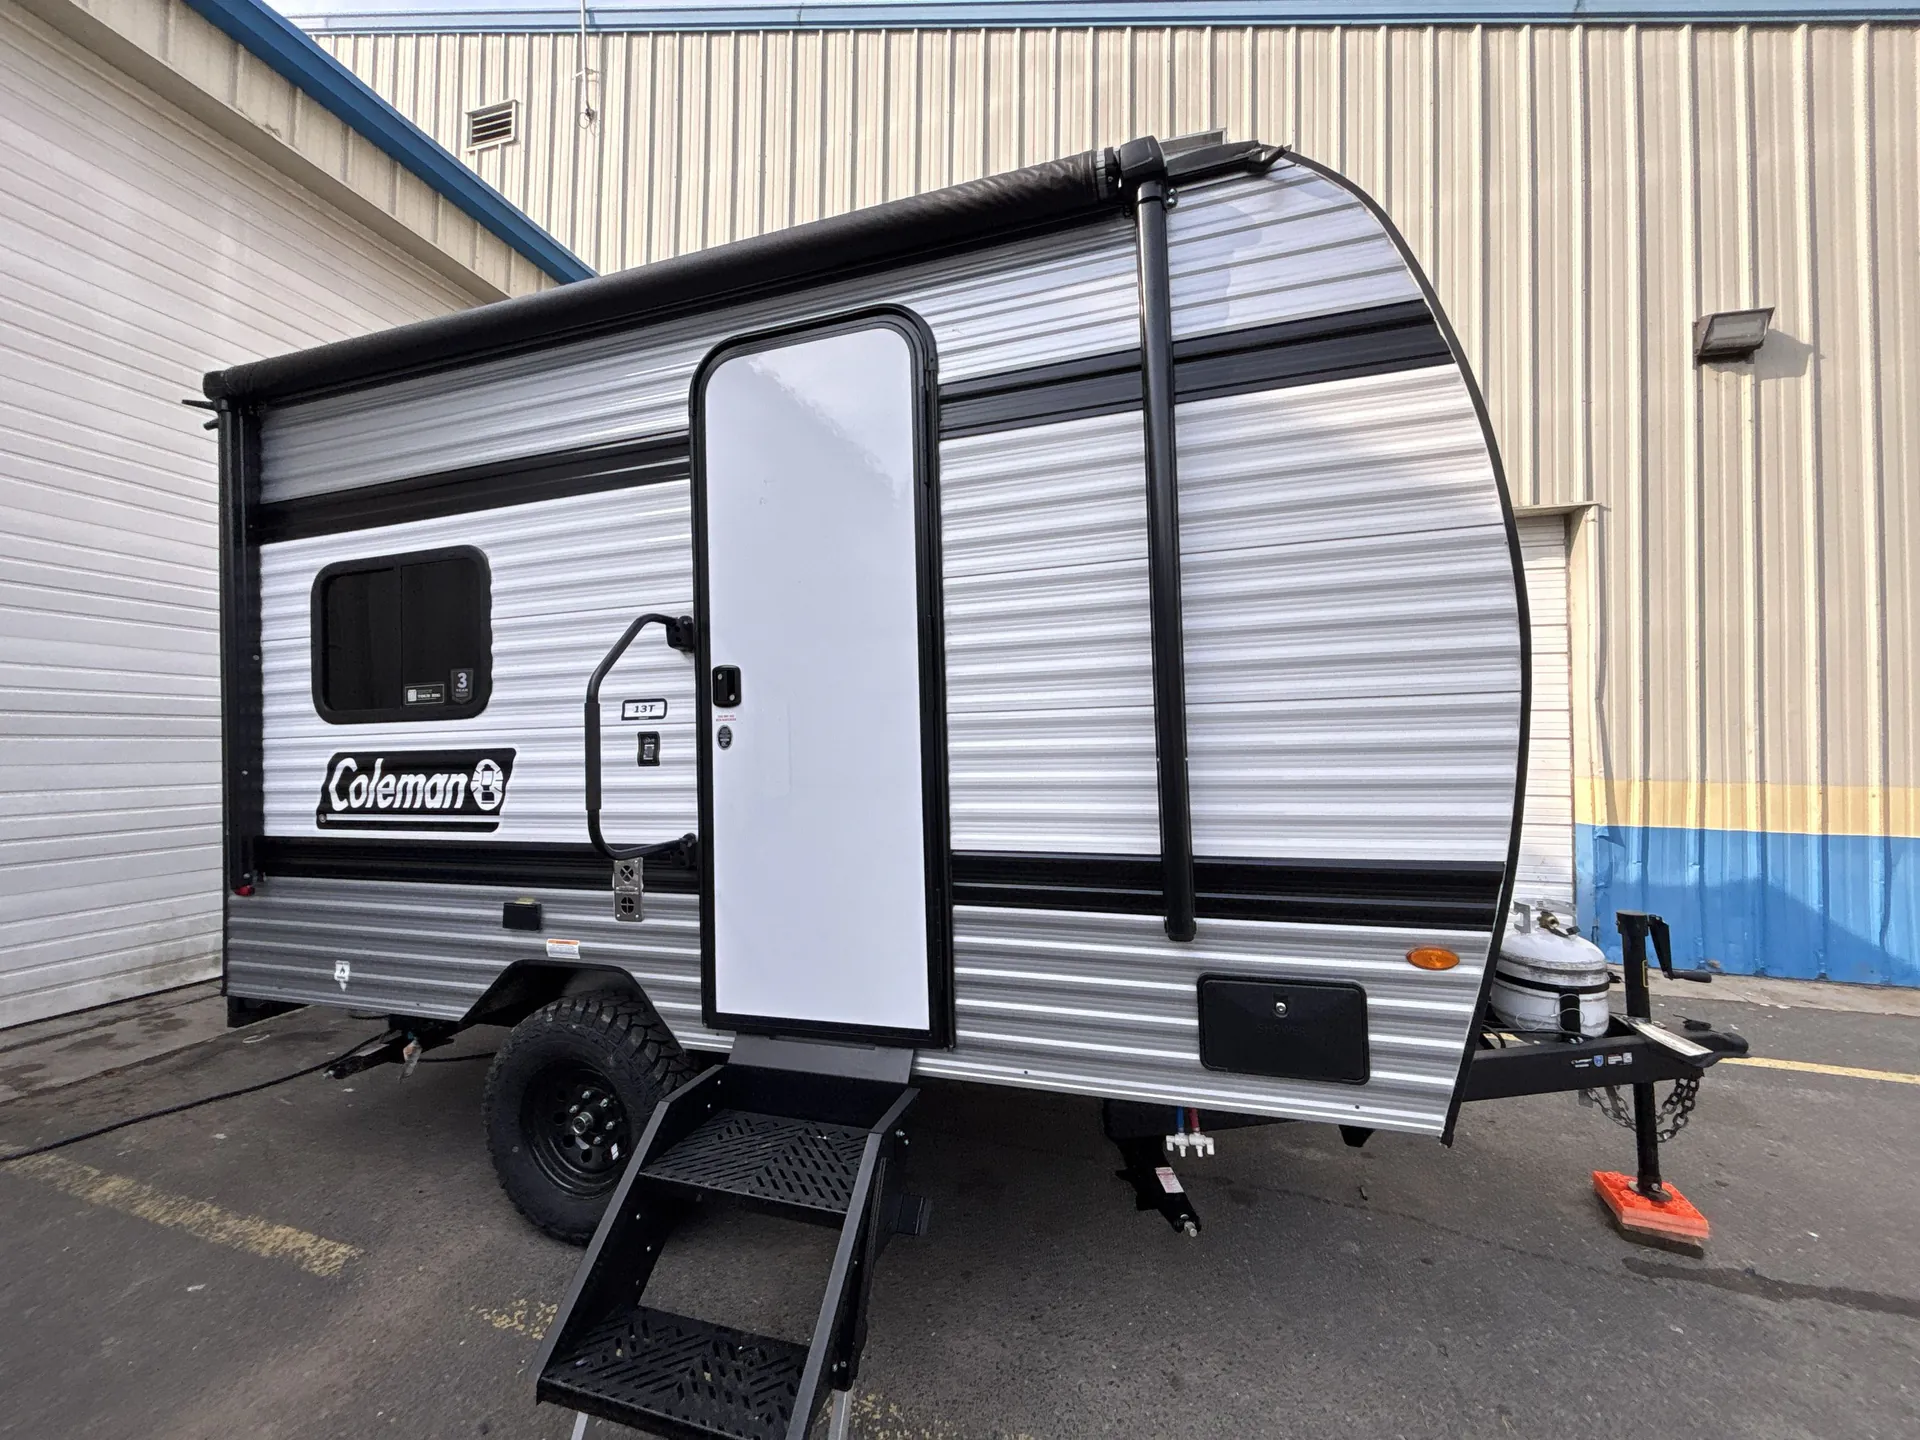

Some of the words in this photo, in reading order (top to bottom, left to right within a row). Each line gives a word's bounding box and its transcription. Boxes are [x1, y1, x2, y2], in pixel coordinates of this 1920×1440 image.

[457, 672, 468, 688] 3
[633, 704, 656, 713] 13T
[328, 757, 468, 811] Coleman
[1256, 1023, 1307, 1037] SHOWER
